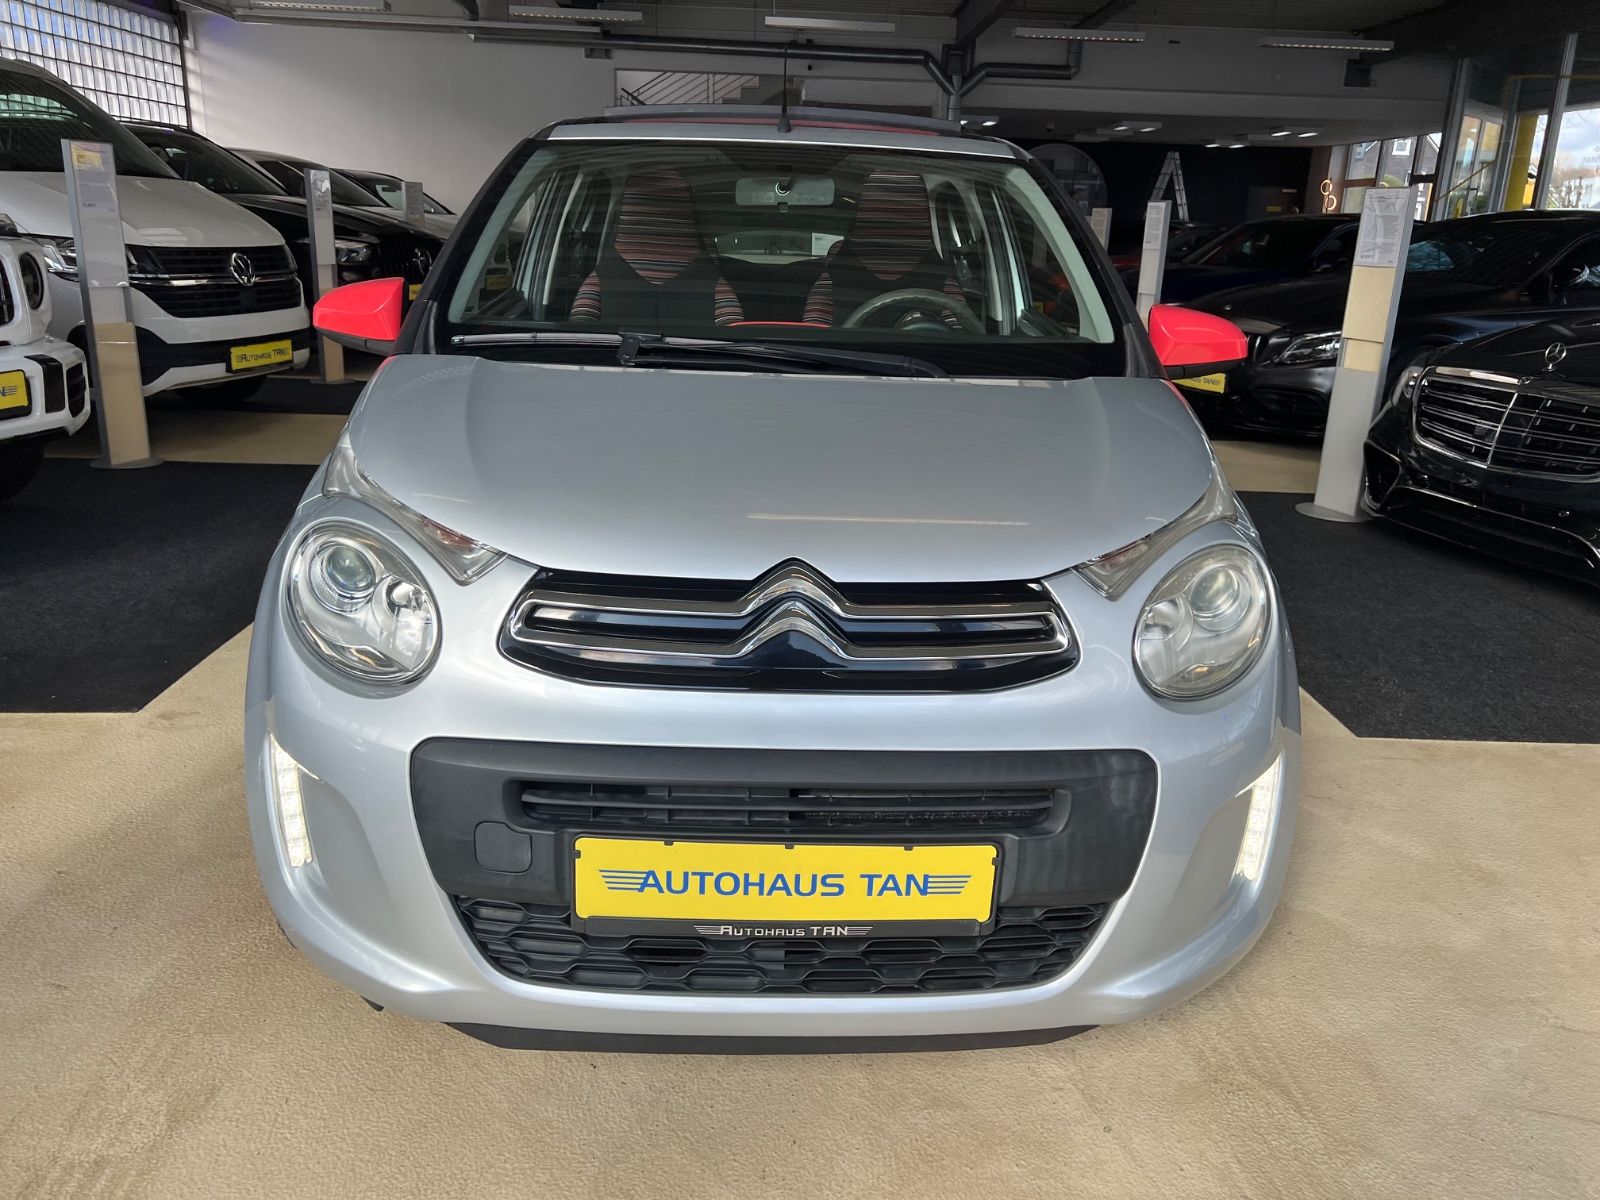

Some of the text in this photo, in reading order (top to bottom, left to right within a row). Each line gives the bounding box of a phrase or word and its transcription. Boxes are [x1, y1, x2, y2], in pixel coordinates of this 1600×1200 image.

[638, 869, 929, 897] AUTOHAUS TAN
[810, 926, 848, 936] TAN
